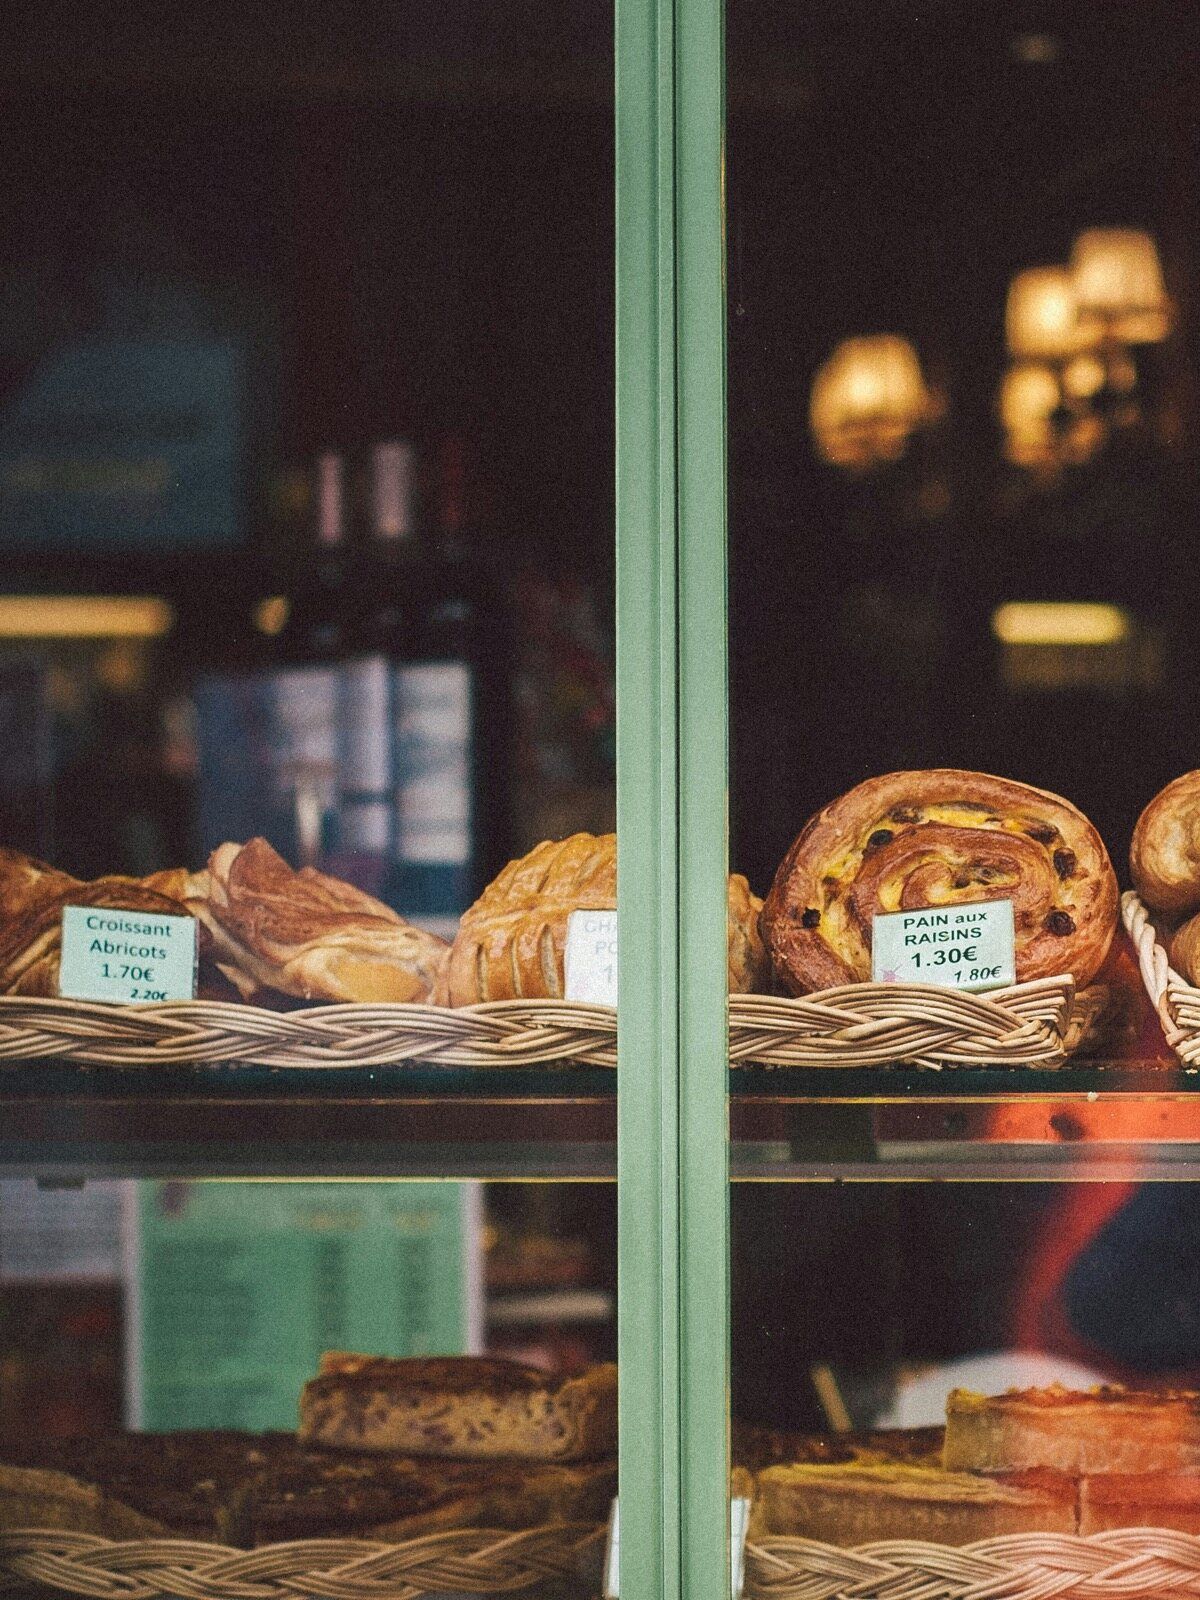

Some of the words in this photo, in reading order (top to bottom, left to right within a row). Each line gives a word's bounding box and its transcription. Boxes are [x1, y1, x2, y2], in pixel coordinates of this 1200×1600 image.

[86, 916, 172, 937] Croissant
[903, 914, 949, 930] PAIN
[954, 912, 988, 924] aux
[904, 926, 982, 947] RAISINS
[89, 939, 167, 960] Abricots
[911, 945, 978, 968] 1.30€
[101, 963, 155, 983] 1.70€
[953, 965, 1002, 984] 1.80€
[130, 988, 169, 1002] 2.20€
